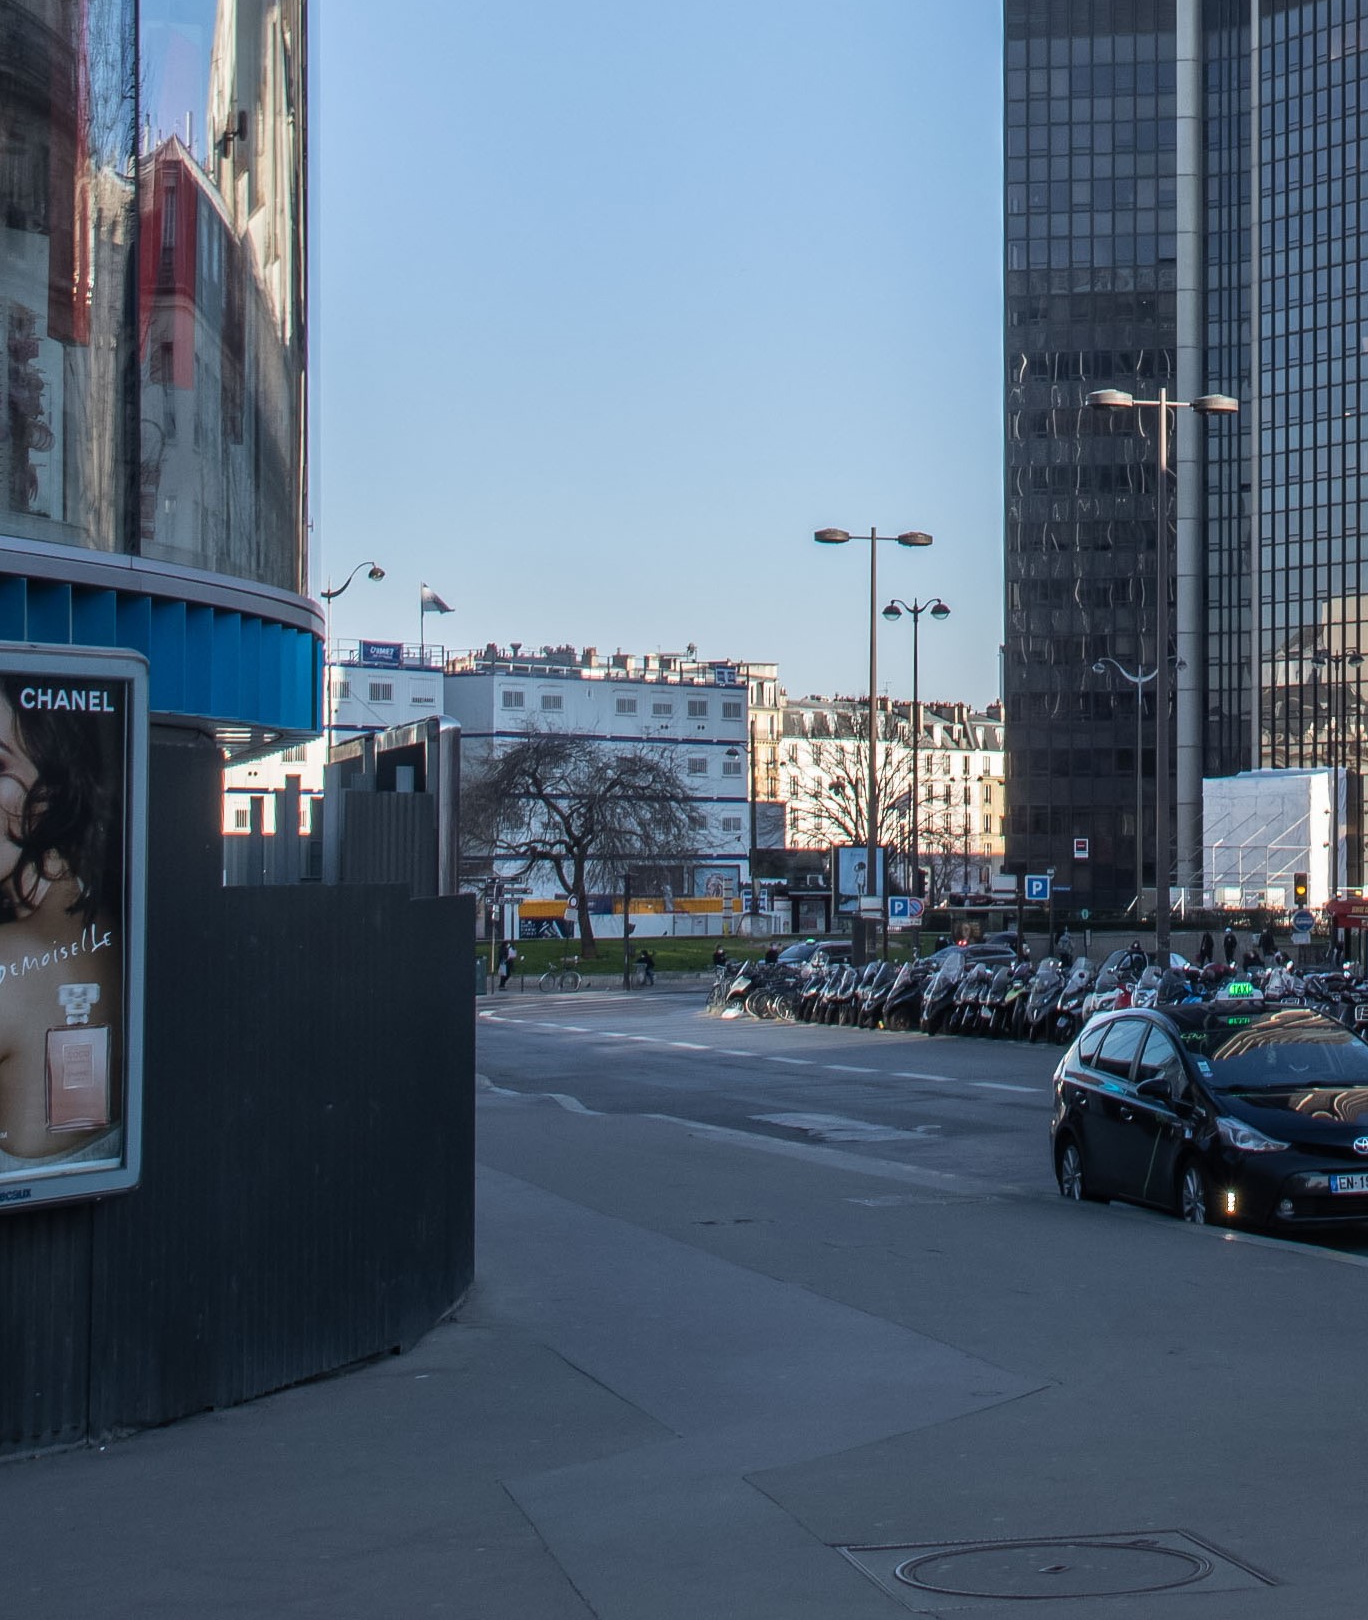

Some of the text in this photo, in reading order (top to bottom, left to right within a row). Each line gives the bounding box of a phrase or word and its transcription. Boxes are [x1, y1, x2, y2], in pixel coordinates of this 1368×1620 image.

[20, 687, 115, 712] CHANEL
[1032, 881, 1043, 895] P
[894, 901, 904, 915] P
[1231, 983, 1251, 994] TAXI
